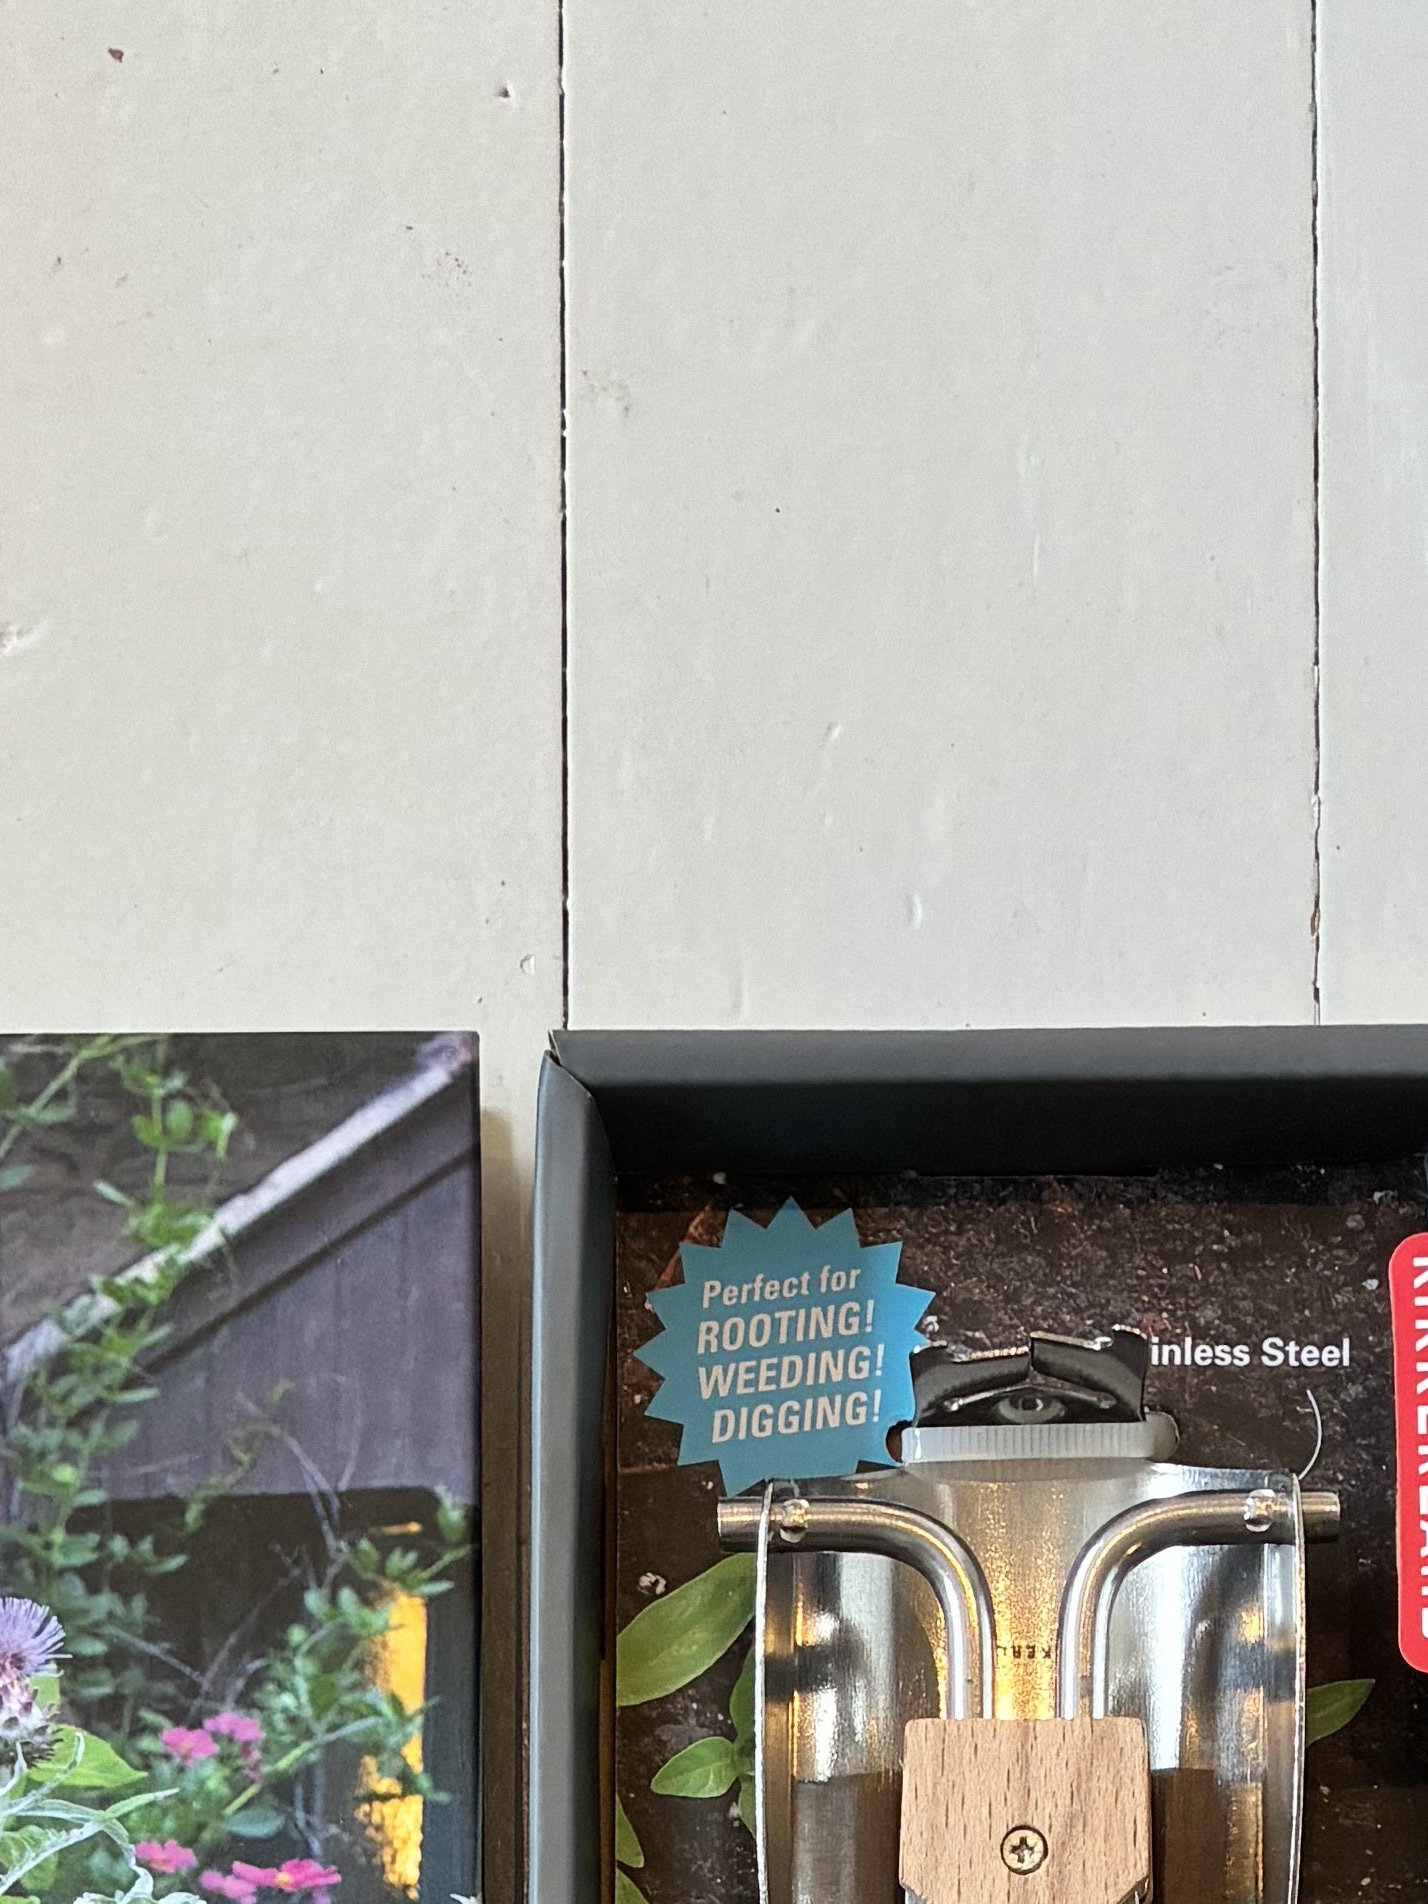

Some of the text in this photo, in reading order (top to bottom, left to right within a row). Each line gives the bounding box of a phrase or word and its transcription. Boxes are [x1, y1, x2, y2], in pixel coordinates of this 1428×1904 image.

[703, 1265, 861, 1308] Perfect for
[698, 1295, 874, 1359] ROOTING!
[1152, 1337, 1350, 1367] inless Steel
[699, 1345, 884, 1400] WEEDING!
[711, 1390, 881, 1444] DIGGING!
